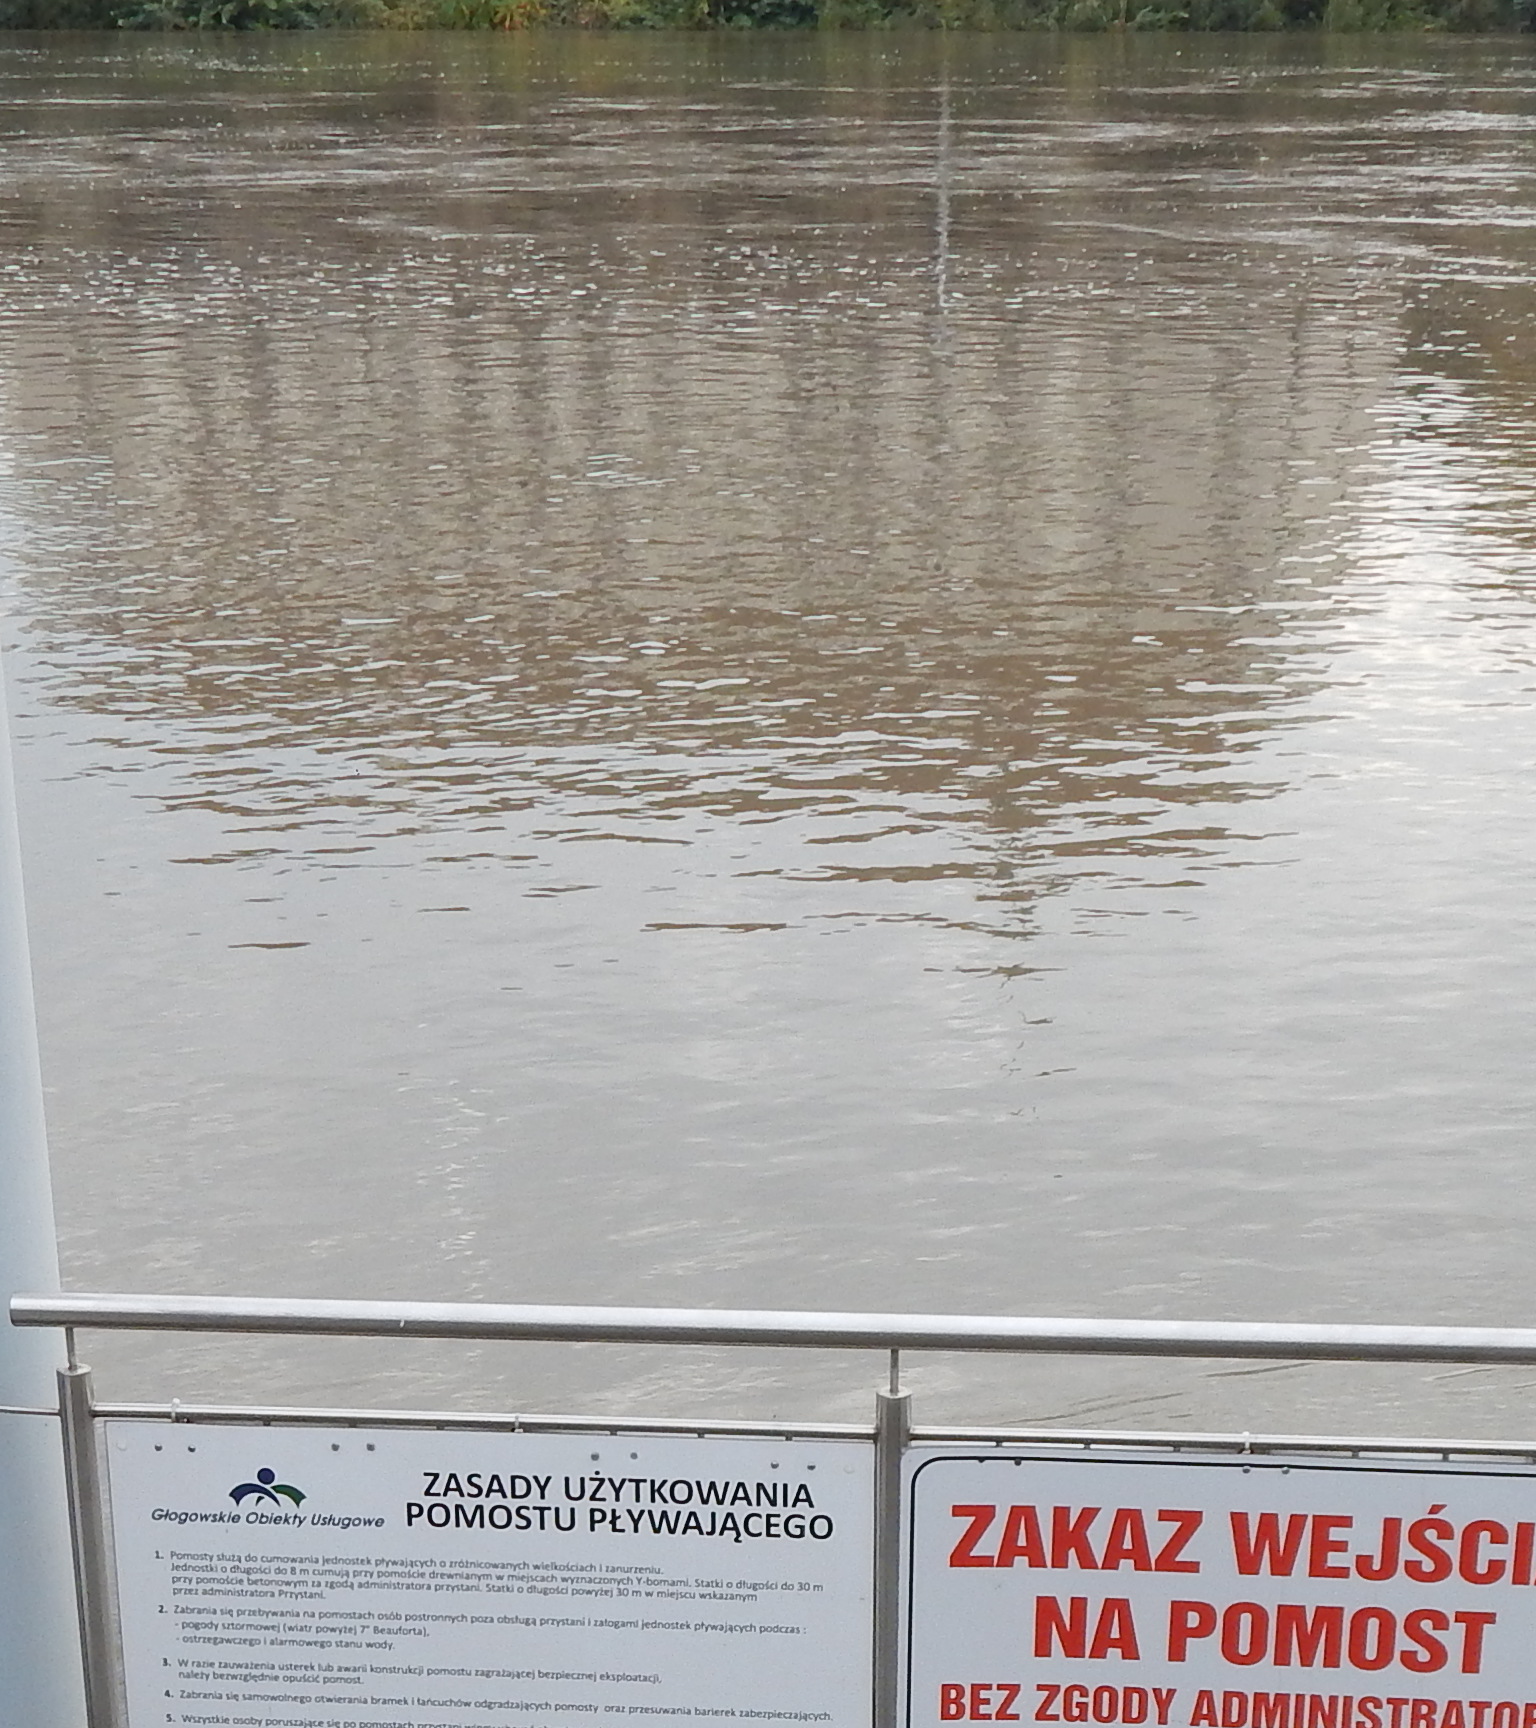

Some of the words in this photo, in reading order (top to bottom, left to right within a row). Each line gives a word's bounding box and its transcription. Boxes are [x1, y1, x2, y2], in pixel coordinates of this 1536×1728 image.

[422, 1471, 552, 1500] ZASADY
[564, 1472, 814, 1508] UŻYTKOWANIA
[151, 1508, 241, 1524] Głogowskie
[245, 1511, 307, 1528] Obiekty
[310, 1513, 384, 1529] Usługowe
[406, 1502, 575, 1531] POMOSTU
[589, 1507, 833, 1542] PŁYWAJĄCEGO
[950, 1506, 1203, 1574] ZAKAZ
[158, 1604, 168, 1613] 2.
[173, 1604, 217, 1615] Zabrania
[219, 1607, 233, 1617] się
[236, 1607, 299, 1618] przebywania
[318, 1611, 374, 1620] pomostach
[377, 1611, 402, 1620] osób
[404, 1613, 467, 1623] postronnych
[470, 1615, 494, 1624] poza
[496, 1614, 536, 1626] obsługą
[539, 1617, 585, 1627] przystani
[593, 1618, 638, 1629] załogami
[640, 1619, 691, 1630] jednostek
[694, 1621, 756, 1633] pływających
[759, 1624, 800, 1634] podczas
[181, 1620, 218, 1631] pogody
[221, 1622, 280, 1633] sztormowej
[282, 1622, 312, 1633] (wiatr
[315, 1625, 356, 1635] powyżej
[373, 1625, 429, 1637] Beauforta),
[182, 1635, 261, 1646] ostrzegawczego
[269, 1637, 332, 1649] alarmowego
[334, 1640, 362, 1648] stanu
[365, 1640, 394, 1650] wody.
[1034, 1597, 1140, 1661] NA
[1168, 1602, 1496, 1674] POMOST
[162, 1657, 171, 1666] 3.
[177, 1658, 188, 1667] W
[191, 1660, 215, 1668] razie
[278, 1661, 315, 1671] usterek
[317, 1662, 333, 1671] lub
[336, 1664, 367, 1672] awarii
[369, 1664, 423, 1676] konstrukcji
[426, 1668, 471, 1676] pomostu
[537, 1669, 596, 1682] bezpiecznej
[212, 1670, 279, 1682] bezwzględnie
[282, 1673, 319, 1683] opuścić
[322, 1676, 363, 1684] pomost.
[164, 1689, 173, 1697] 4.
[179, 1689, 222, 1699] Zabrania
[225, 1691, 238, 1701] się
[242, 1693, 311, 1704] samowolnego
[314, 1695, 367, 1704] otwierania
[370, 1695, 408, 1705] bramek
[417, 1697, 471, 1707] łańcuchów
[474, 1699, 551, 1711] odgradzających
[554, 1703, 598, 1713] pomosty
[628, 1706, 691, 1715] przesuwania
[694, 1706, 735, 1716] barierek
[739, 1708, 833, 1721] zabezpieczających.
[941, 1685, 1021, 1721] BEZ
[1035, 1686, 1176, 1725] ZGODY
[166, 1713, 175, 1722] 5.
[181, 1714, 229, 1724] Wszystkie
[232, 1716, 262, 1727] osoby
[265, 1718, 324, 1728] poruszające
[326, 1719, 340, 1728] się
[343, 1721, 356, 1728] po
